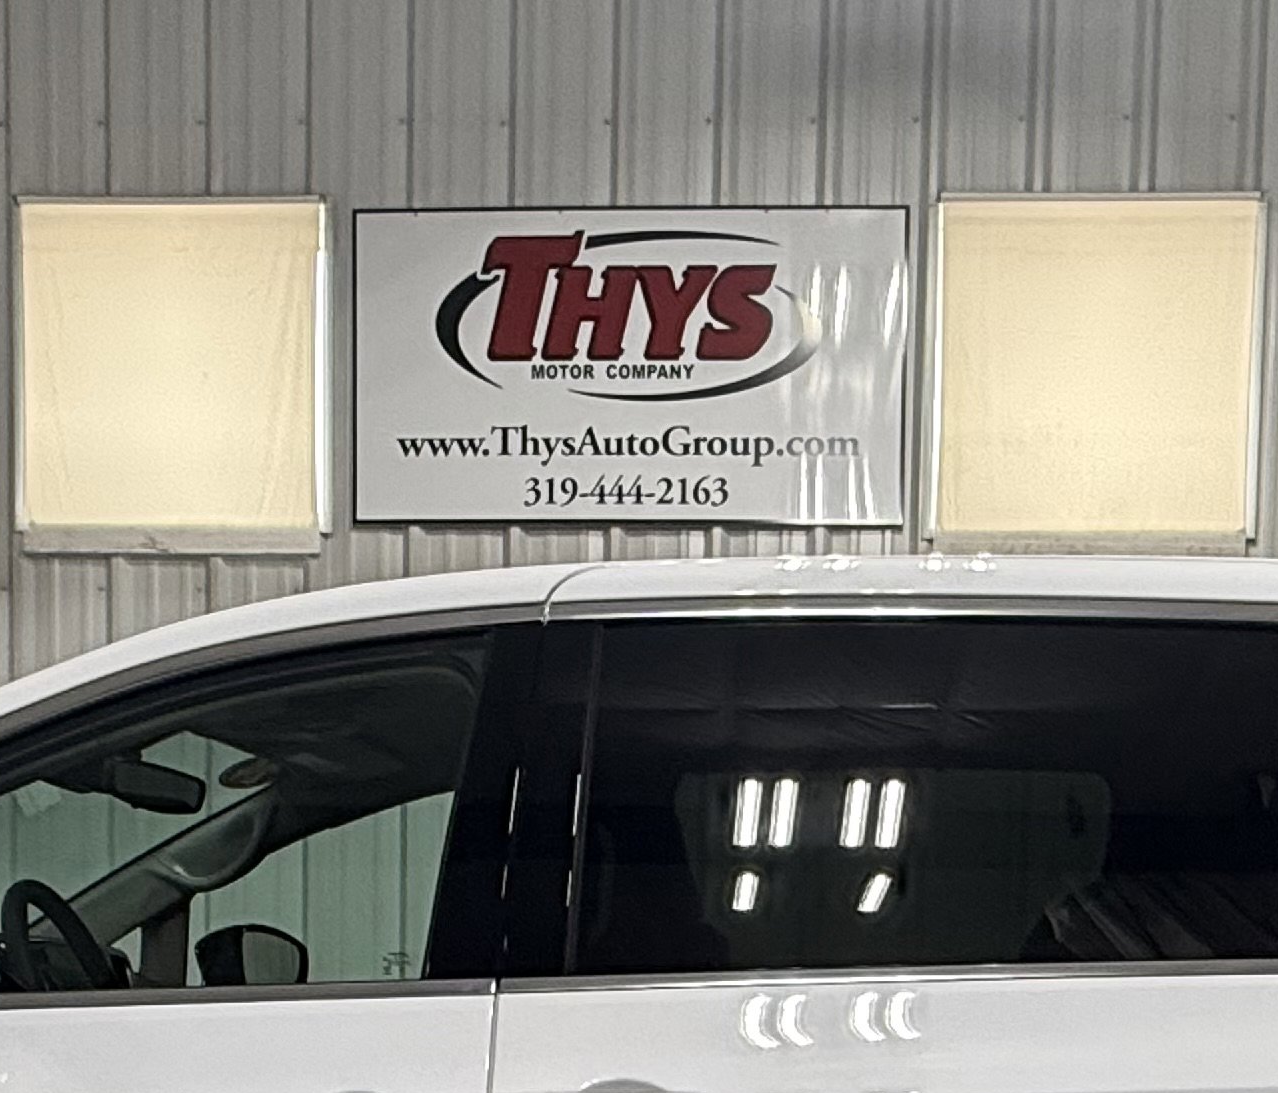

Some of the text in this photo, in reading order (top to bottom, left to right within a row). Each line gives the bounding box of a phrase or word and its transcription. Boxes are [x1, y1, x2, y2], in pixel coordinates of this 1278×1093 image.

[481, 229, 778, 362] THYS
[530, 363, 695, 380] MOTOR COMPANY
[396, 425, 860, 466] www.ThysAutoGroup.com
[522, 474, 730, 508] 319-444-2163
